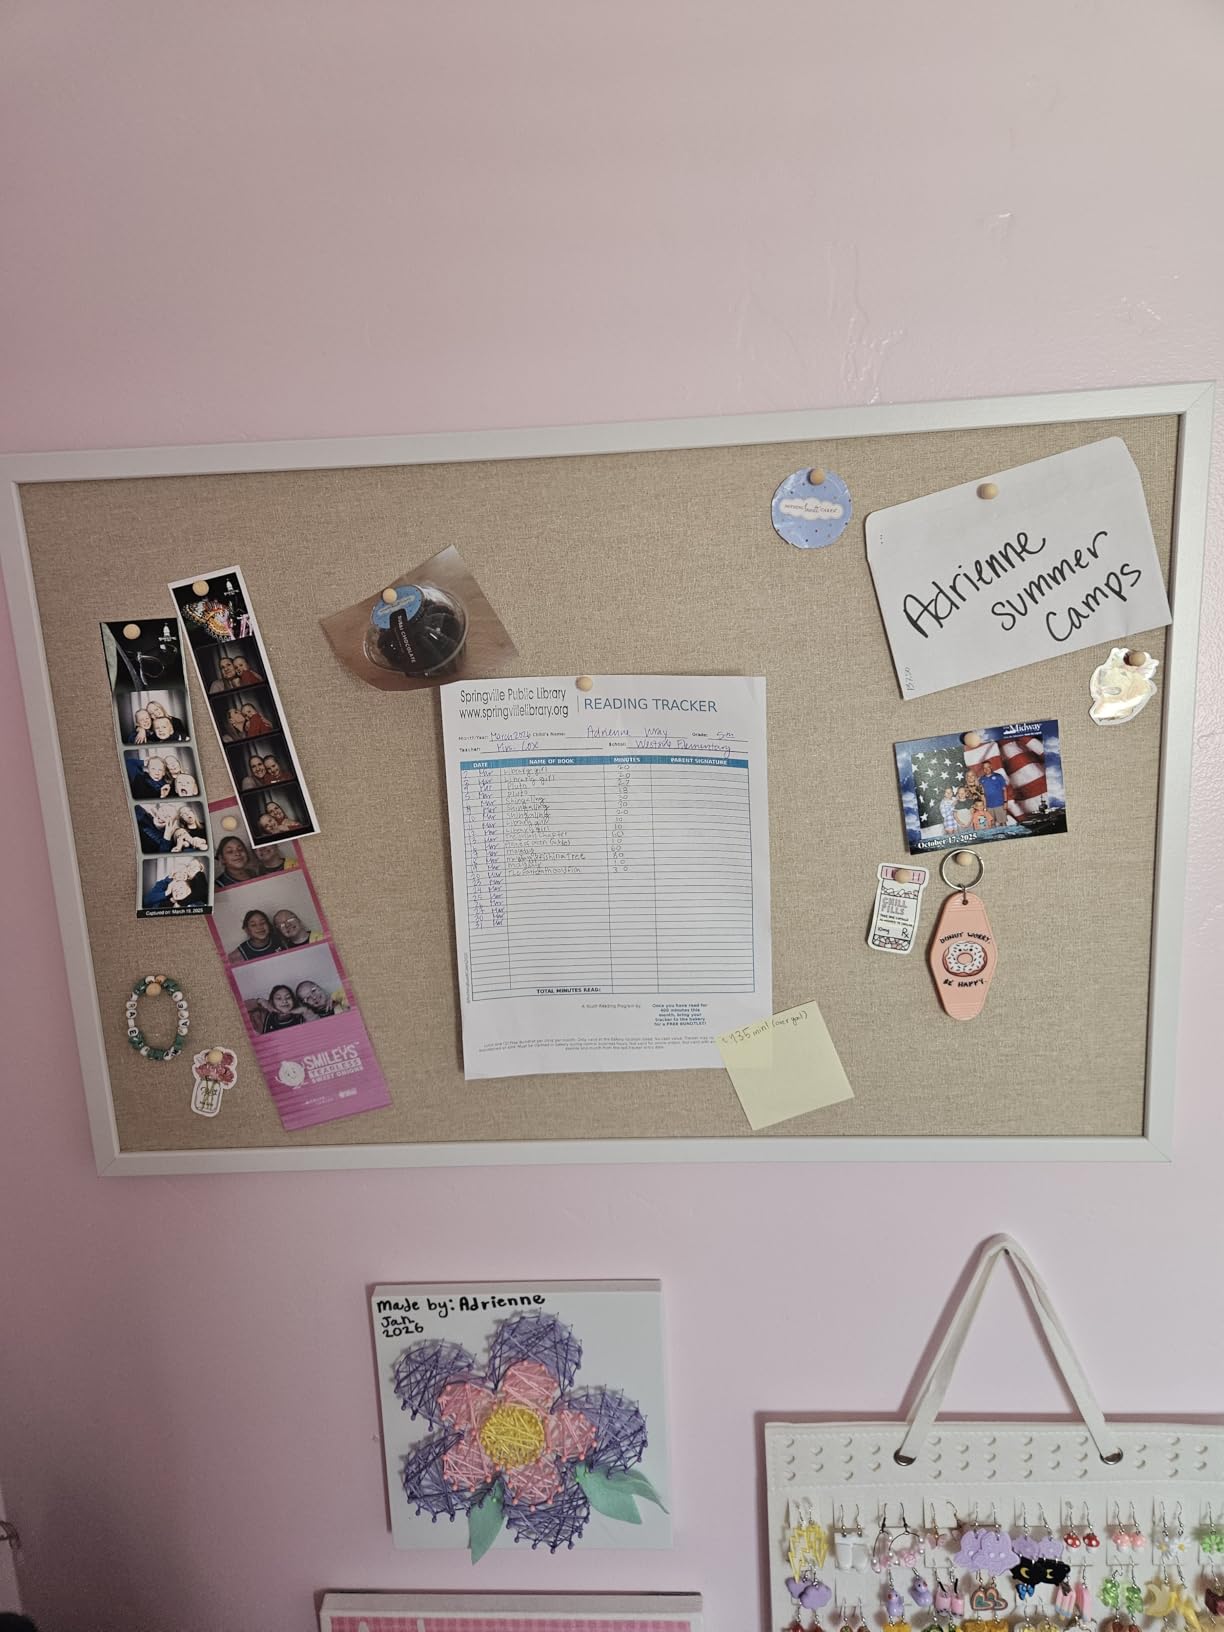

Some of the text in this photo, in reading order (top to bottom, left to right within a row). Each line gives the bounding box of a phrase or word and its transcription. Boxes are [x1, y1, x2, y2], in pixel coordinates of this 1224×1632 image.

[903, 531, 1047, 639] Adrienne
[401, 631, 417, 664] CHOCOLATE
[460, 687, 568, 705] Springville Public Library
[459, 705, 570, 721] www.springvillelibrary.org
[584, 698, 718, 713] READING TRACKER
[587, 724, 668, 740] Adrienne Wray
[1009, 723, 1041, 732] Midway
[490, 731, 513, 742] March
[694, 757, 728, 765] SIGNATURE
[918, 839, 947, 849] October
[960, 833, 977, 842] 2025
[881, 904, 905, 915] PILLS
[882, 897, 908, 908] CHILL
[940, 932, 964, 943] DONUT
[943, 978, 954, 986] BE
[303, 1044, 359, 1070] SMILEY'S
[376, 1294, 546, 1318] Made by: Adrienne
[381, 1315, 416, 1329] Jan
[382, 1324, 425, 1339] 2026
